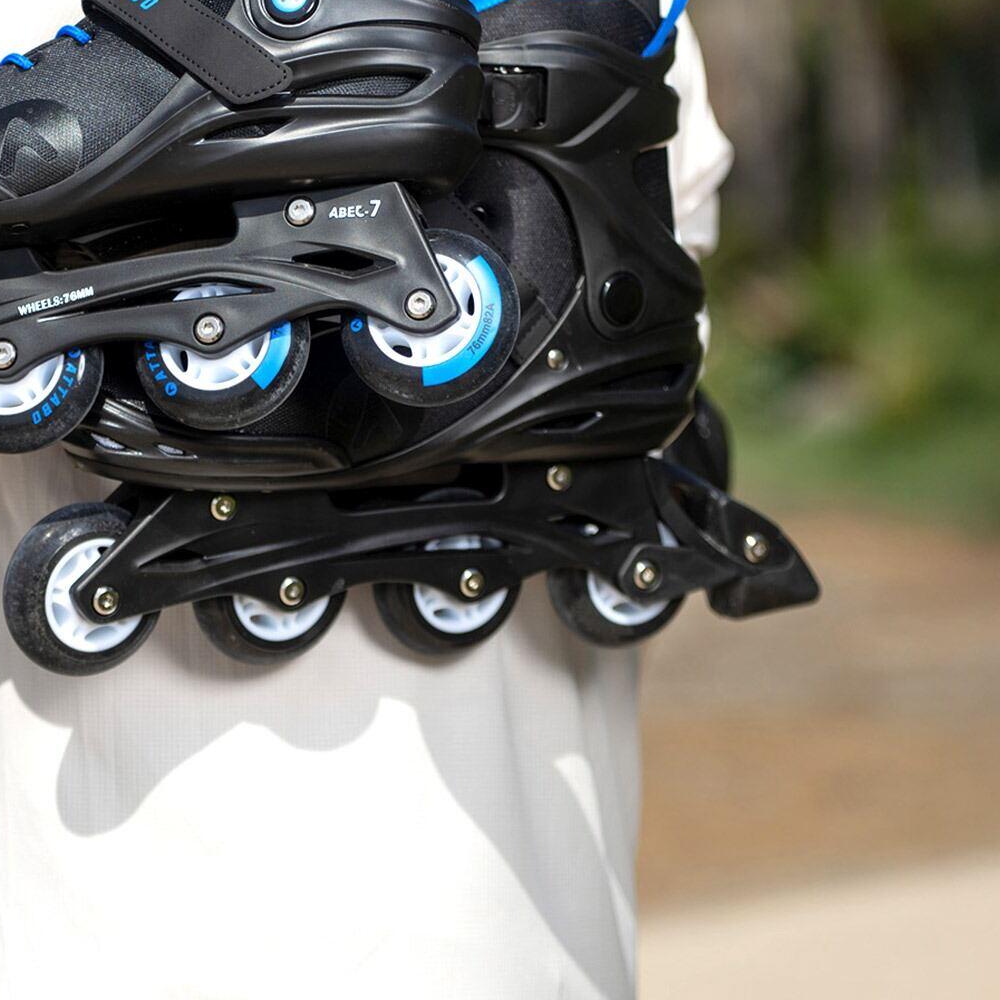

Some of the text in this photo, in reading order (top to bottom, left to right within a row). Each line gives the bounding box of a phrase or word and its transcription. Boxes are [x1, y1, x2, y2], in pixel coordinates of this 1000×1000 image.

[328, 199, 381, 219] ABEC-7
[18, 286, 94, 316] WHEELS:76MM
[468, 303, 495, 355] 76mm82A
[30, 362, 77, 425] ATTABO
